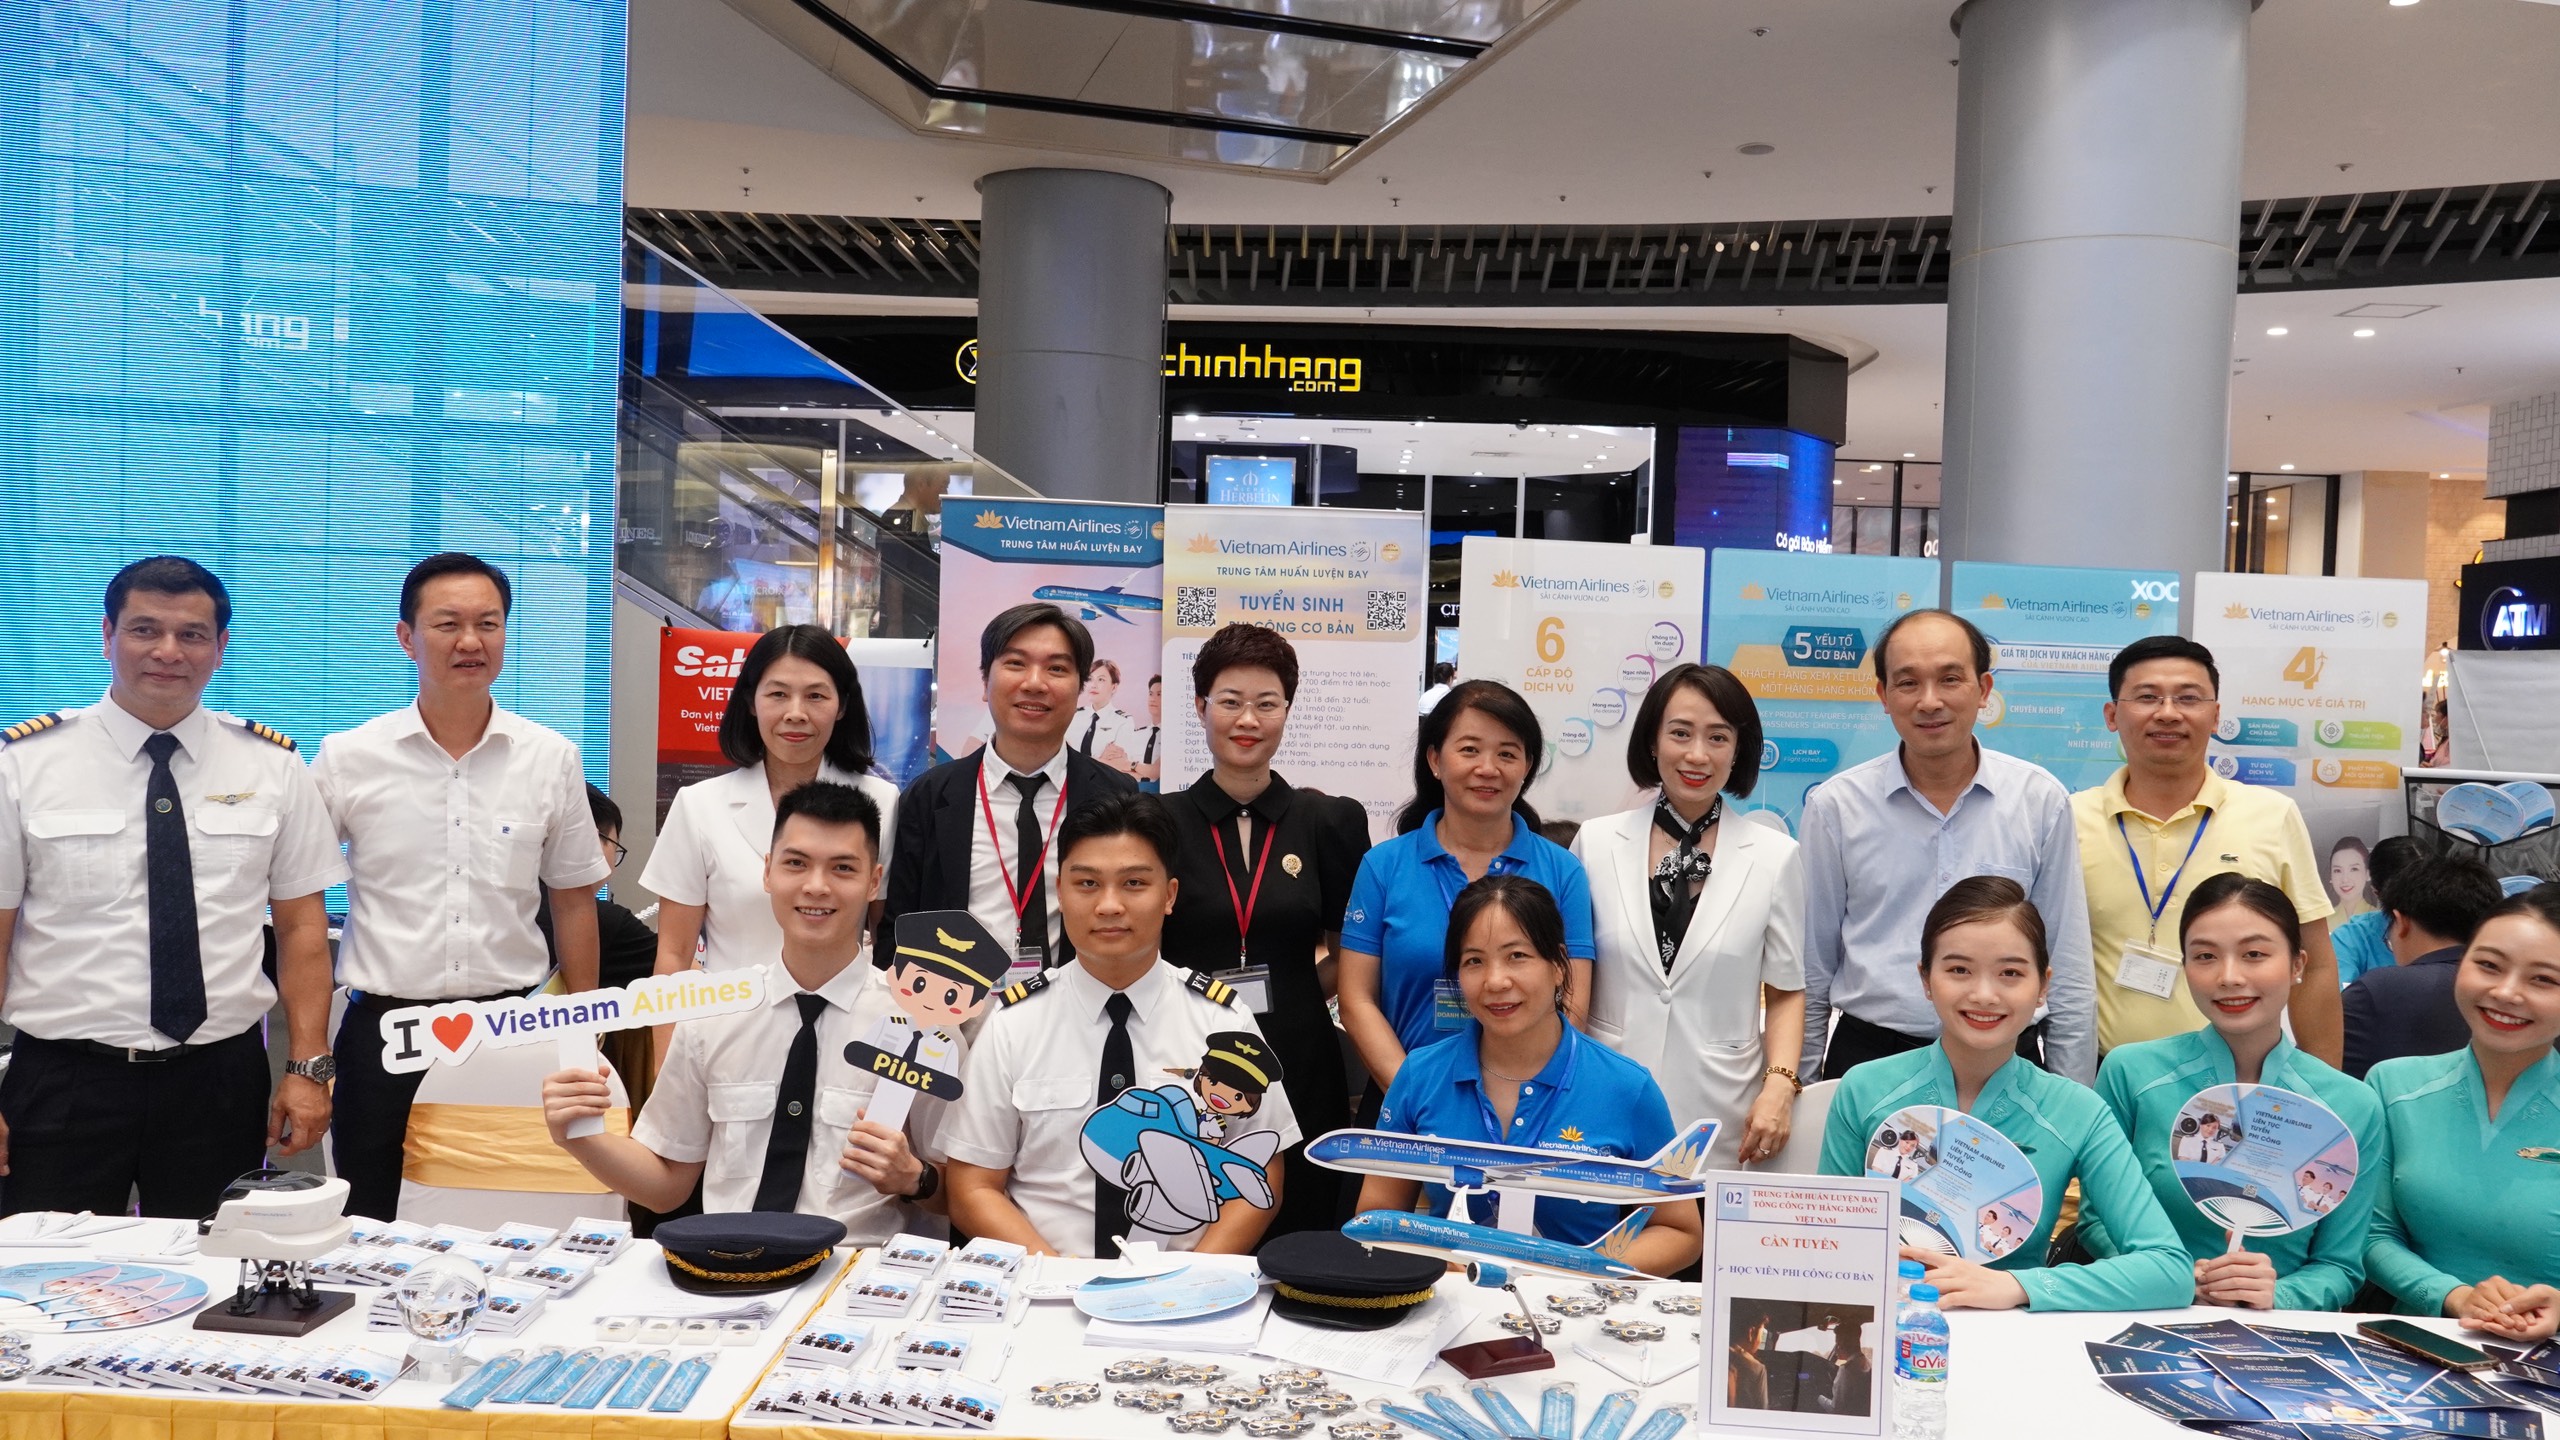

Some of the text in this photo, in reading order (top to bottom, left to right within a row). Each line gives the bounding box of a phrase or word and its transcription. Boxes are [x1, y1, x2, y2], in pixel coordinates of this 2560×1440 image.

[1288, 380, 1336, 393] .com
[1220, 489, 1280, 504] HERBELIN
[1004, 516, 1067, 532] Vietnam
[1067, 519, 1121, 534] Airlines
[1001, 539, 1143, 555] TRUNG TÂM HUẤN LUYỆN BAY
[1220, 539, 1347, 556] Vietnam Airlines
[1776, 532, 1787, 548] Có
[1788, 533, 1800, 553] gói
[1801, 535, 1815, 552] Bảo
[1217, 566, 1369, 580] TRUNG TÂM HUẤN LUYỆN BAY
[1520, 575, 1630, 593] Vietnam Airlines
[1240, 589, 1344, 613] TUYỂN SINH
[1552, 593, 1610, 603] CÁNH CAO
[1766, 587, 1869, 605] Vietnam Airlines
[1795, 605, 1814, 613] CÁNH
[2006, 598, 2109, 614] Vietnam Airlines
[2250, 607, 2354, 624] Vietnam Airlines
[2492, 604, 2547, 637] ATM
[1301, 621, 1323, 634] CƠ
[1327, 620, 1354, 635] BẢN
[1536, 616, 1565, 663] 6
[1793, 632, 1812, 660] 5
[1815, 633, 1853, 647] YẾU TỐ
[1814, 647, 1856, 661] CƠ BẢN
[2001, 648, 2110, 662] GIÁ TRỊ DỊCH VỤ KHÁCH HÀNG
[1526, 665, 1573, 680] CẤP ĐỘ
[2041, 661, 2078, 670] VIETNAM
[2283, 646, 2320, 690] 4
[1310, 671, 1347, 679] trung học
[1740, 668, 1852, 682] KHÁCH HÀNG XEM XÉT
[1524, 682, 1574, 694] DỊCH VỤ
[1760, 683, 1845, 695] MỘT HÀNG
[2009, 704, 2065, 715] CHUYÊN NGHIỆP
[2242, 696, 2366, 710] HẠNG MỤC VỀ GIÁ TRỊ
[681, 709, 713, 722] Đơn vị
[1775, 711, 1809, 719] PRODUCT
[1810, 711, 1846, 720] FEATURES
[694, 723, 721, 733] Vietn
[1812, 721, 1840, 730] CHOICE
[394, 978, 752, 1061] I Vietnam Airlines
[873, 1053, 933, 1090] Pilot
[2255, 1110, 2313, 1130] VIETNAM AIRLINES
[1375, 1137, 1446, 1155] Vietnam Airlines
[1538, 1140, 1598, 1155] Vietnam Airlines
[2260, 1134, 2282, 1146] CÔNG
[1950, 1144, 1976, 1162] LIÊN TỤC
[1954, 1138, 2006, 1171] VIETNAM AIRLINES
[1942, 1159, 1973, 1179] PHI CÔNG
[1726, 1191, 1743, 1205] 02
[1752, 1190, 1782, 1198] TRUNG
[1784, 1191, 1803, 1199] TÂM
[1831, 1194, 1860, 1203] LUYỆN
[1861, 1196, 1879, 1204] BAY
[1779, 1201, 1804, 1210] CÔNG
[1819, 1203, 1844, 1212] HÀNG
[1845, 1205, 1878, 1214] KHÔNG
[1795, 1215, 1837, 1225] VIỆT NAM
[1412, 1220, 1470, 1239] Vietnam Airlines
[1761, 1234, 1839, 1250] CẦN TUYỂN
[1729, 1265, 1875, 1282] HỌC VIÊN PHI CÔNG CƠ BẢN
[1913, 1355, 1947, 1369] laVie
